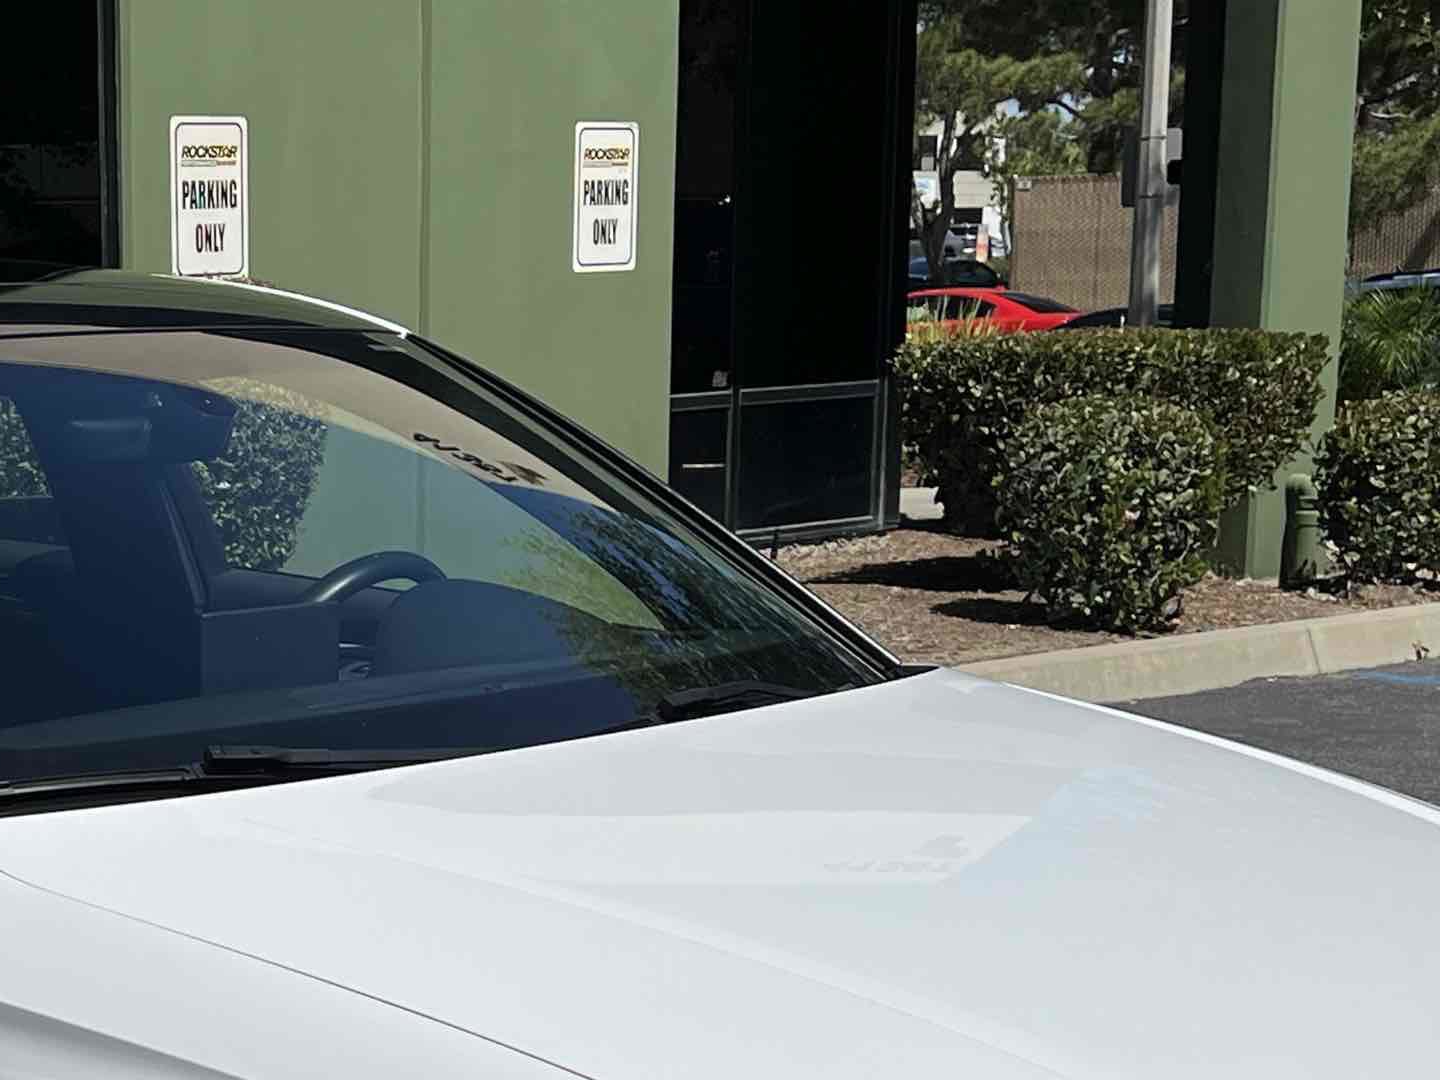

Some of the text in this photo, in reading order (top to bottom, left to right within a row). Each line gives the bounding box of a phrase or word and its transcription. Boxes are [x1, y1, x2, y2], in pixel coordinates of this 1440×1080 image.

[181, 145, 238, 158] ROCKSTAR
[181, 179, 238, 210] PARKING
[583, 179, 629, 206] PARKING
[195, 223, 226, 253] ONLY
[592, 218, 618, 245] ONLY
